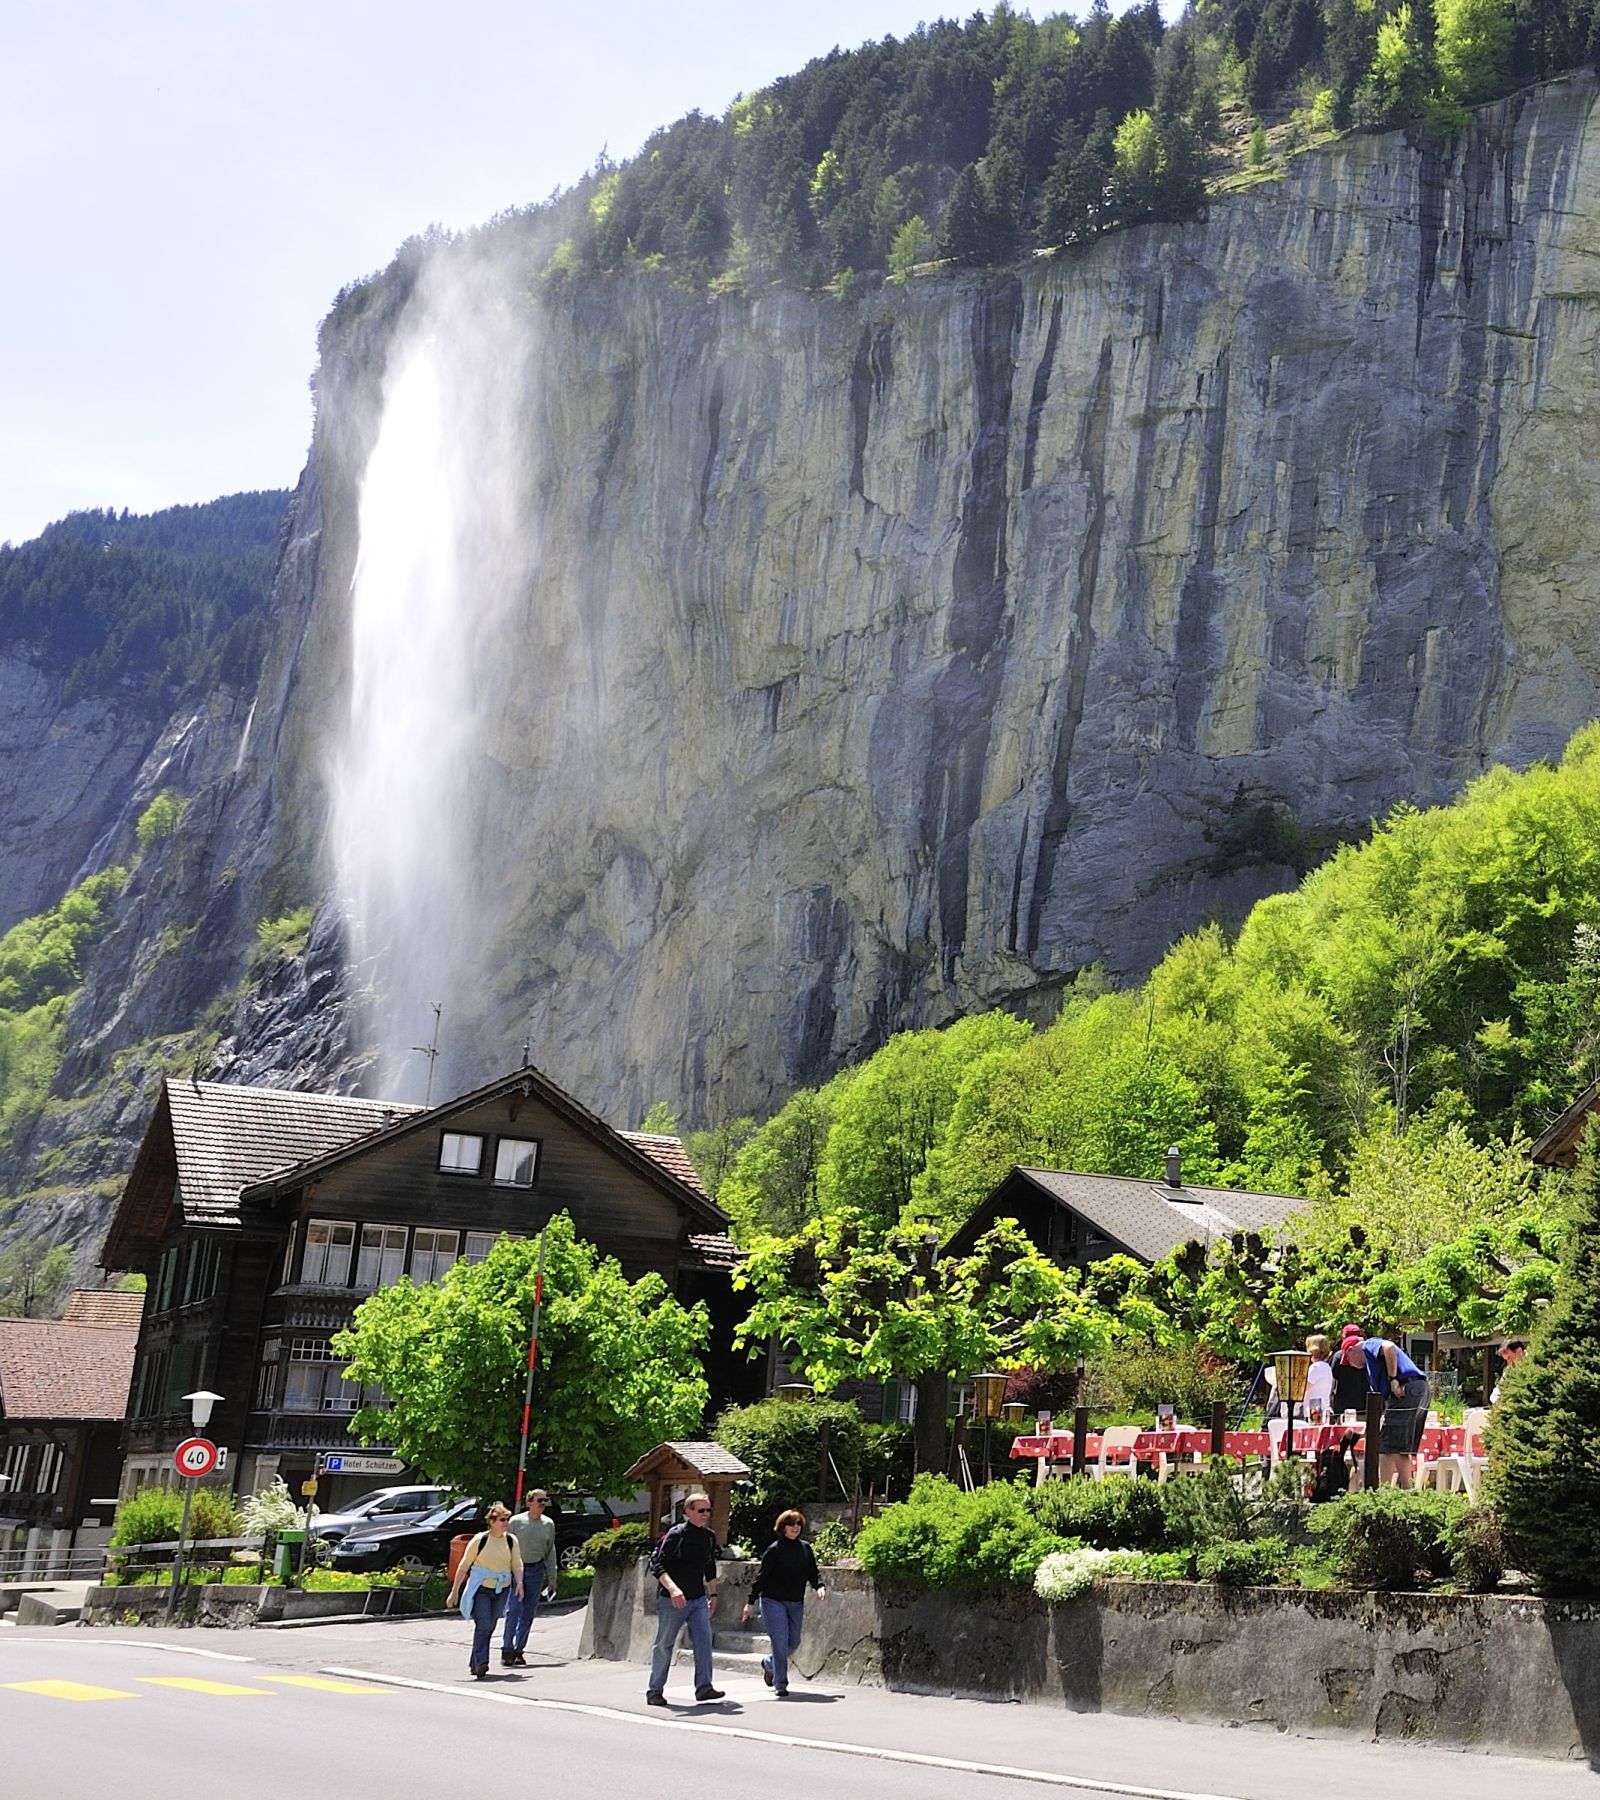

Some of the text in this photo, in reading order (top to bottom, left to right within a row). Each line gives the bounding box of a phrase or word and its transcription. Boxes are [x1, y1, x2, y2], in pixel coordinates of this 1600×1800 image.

[187, 1451, 205, 1465] 40
[331, 1458, 339, 1469] P
[343, 1460, 362, 1468] Hotel
